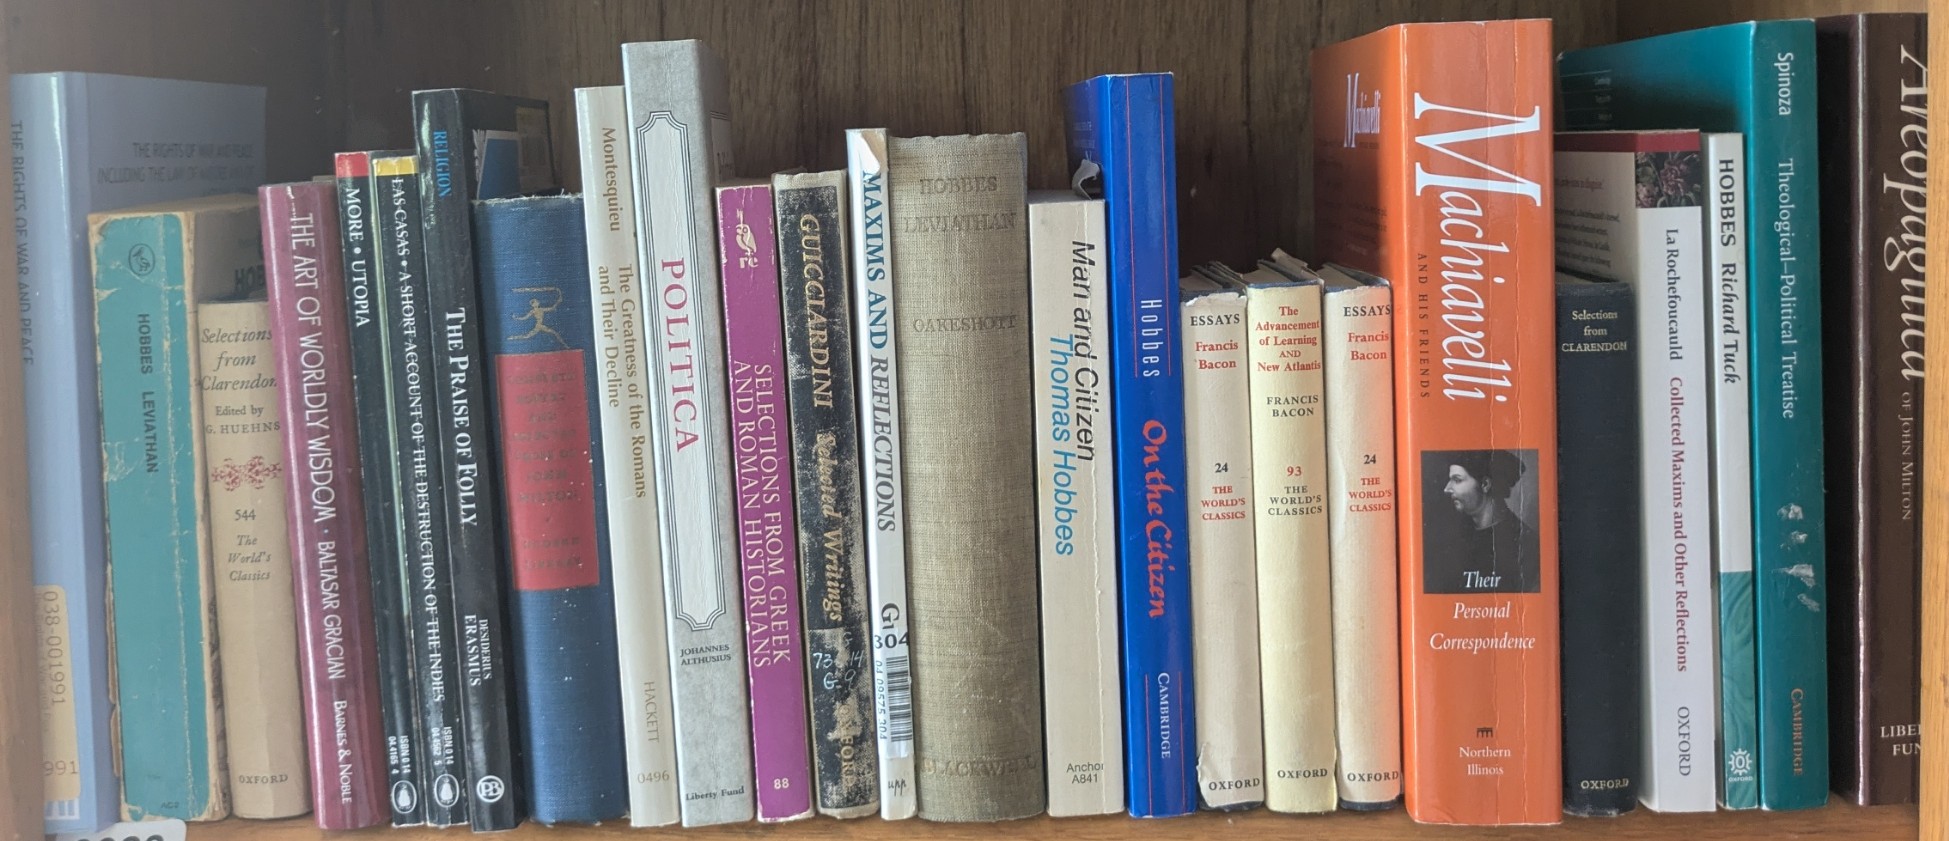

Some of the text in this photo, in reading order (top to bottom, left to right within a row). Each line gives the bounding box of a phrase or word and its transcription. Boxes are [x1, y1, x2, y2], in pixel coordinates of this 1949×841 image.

[1773, 52, 1796, 117] Spinoza
[433, 130, 452, 198] RELIGION
[601, 127, 623, 232] Montesquieu
[919, 175, 998, 195] HOBBES
[12, 156, 30, 276] RIGHTS WAR
[903, 211, 1019, 233] LEVIATHAN
[1414, 92, 1542, 402] Machiavelli
[345, 187, 371, 328] MORE UTOPIA
[1719, 158, 1741, 385] HOBBES Richard Tuck
[1665, 228, 1684, 361] La Rochefoucauld
[1189, 313, 1241, 327] ESSAYS
[1278, 305, 1299, 317] The
[1343, 304, 1391, 318] ESSAYS
[1571, 309, 1618, 322] Selections
[912, 313, 1018, 333] OAKESHOTT
[1255, 319, 1321, 332] Advancement
[1417, 252, 1431, 399] AND HIS FRIENDS
[1583, 324, 1608, 337] from
[200, 327, 273, 345] Selections
[598, 265, 623, 408] and Their Decline
[1140, 298, 1163, 378] Hobbes
[1259, 334, 1318, 348] of Learning
[1348, 332, 1390, 343] Francis
[661, 257, 700, 453] POLITICA
[862, 170, 896, 532] MAXIMS AND REFLECTIONS
[1071, 240, 1100, 462] Man and Citizen
[1195, 340, 1239, 352] Francis
[1279, 349, 1302, 359] AND
[1561, 340, 1628, 352] CLARENDON
[212, 350, 257, 373] from
[1198, 359, 1237, 370] Bacon
[1350, 350, 1388, 361] Bacon
[291, 213, 338, 525] THE ART OF WORLDLY WISDOM
[1257, 360, 1322, 372] New Atlantis
[617, 263, 648, 498] The Greatness of the Romans
[1781, 351, 1798, 420] Treatise
[137, 314, 159, 474] HOBBES LEVIATHAN
[1266, 394, 1320, 406] FRANCIS
[215, 404, 265, 419] Edited by
[445, 307, 479, 526] THE PRAISE OF FOLLY
[800, 213, 843, 622] GUICCIARDINI Selected Writings
[1271, 407, 1315, 418] BACON
[220, 420, 281, 435] HUEHNS
[391, 178, 446, 703] LAS CASAS A SHORT ACCOUNT OF THE DESTRUCTION OF THE INDIES
[1050, 333, 1079, 556] Thomas Hobbes
[1214, 462, 1229, 474] 24
[1363, 454, 1378, 465] 24
[1898, 413, 1914, 521] JOHN MILTON
[1286, 465, 1303, 477] 93
[1212, 485, 1233, 495] THE
[1284, 485, 1309, 495] THE
[1360, 477, 1381, 486] THE
[1200, 497, 1246, 508] WORLD'S
[1269, 494, 1322, 506] WORLD'S
[1348, 488, 1393, 500] WORLD'S
[234, 509, 257, 522] 544
[734, 360, 771, 668] AND ROMAN HISTORIANS
[754, 364, 791, 665] SELECTIONS FROM GREEK
[1201, 509, 1246, 521] CLASSICS
[1267, 505, 1323, 516] CLASSICS
[1349, 502, 1392, 513] CLASSICS
[1142, 419, 1176, 620] On the Citizen
[1669, 376, 1691, 673] Collected Maxims and Other Reflections
[236, 533, 258, 547] The
[227, 550, 272, 565] World's
[229, 569, 271, 582] Classics
[1463, 570, 1502, 589] Their
[317, 540, 346, 681] BALTASAR GRACIAN
[1452, 601, 1511, 619] Personal
[42, 590, 67, 705] 038-001991
[464, 613, 482, 687] ERASMUS
[479, 618, 493, 681] DESIDERIUS
[680, 643, 730, 657] JOHANNES
[1429, 631, 1536, 654] Correspondence
[681, 653, 732, 666] ALTHUSIUS
[643, 681, 660, 744] HACKETT
[1157, 671, 1172, 760] CAMBRIDGE
[443, 726, 455, 747] ISBN
[1790, 687, 1806, 776] CAMBRIDGE
[399, 735, 411, 756] ISBN
[1676, 706, 1692, 777] OXFORD
[333, 700, 352, 805] BARNES NOBLE
[1458, 745, 1512, 758] Northern
[637, 770, 670, 784] 0496
[1277, 768, 1328, 780] OXFORD
[1347, 770, 1400, 783] OXFORD
[1466, 763, 1504, 776] Illinois
[238, 773, 289, 785] OXFORD
[773, 777, 790, 790] 88
[1071, 773, 1098, 785] A841
[1208, 777, 1261, 791] OXFORD
[1580, 777, 1630, 790] OXFORD
[685, 785, 745, 803] Liberty Fund
